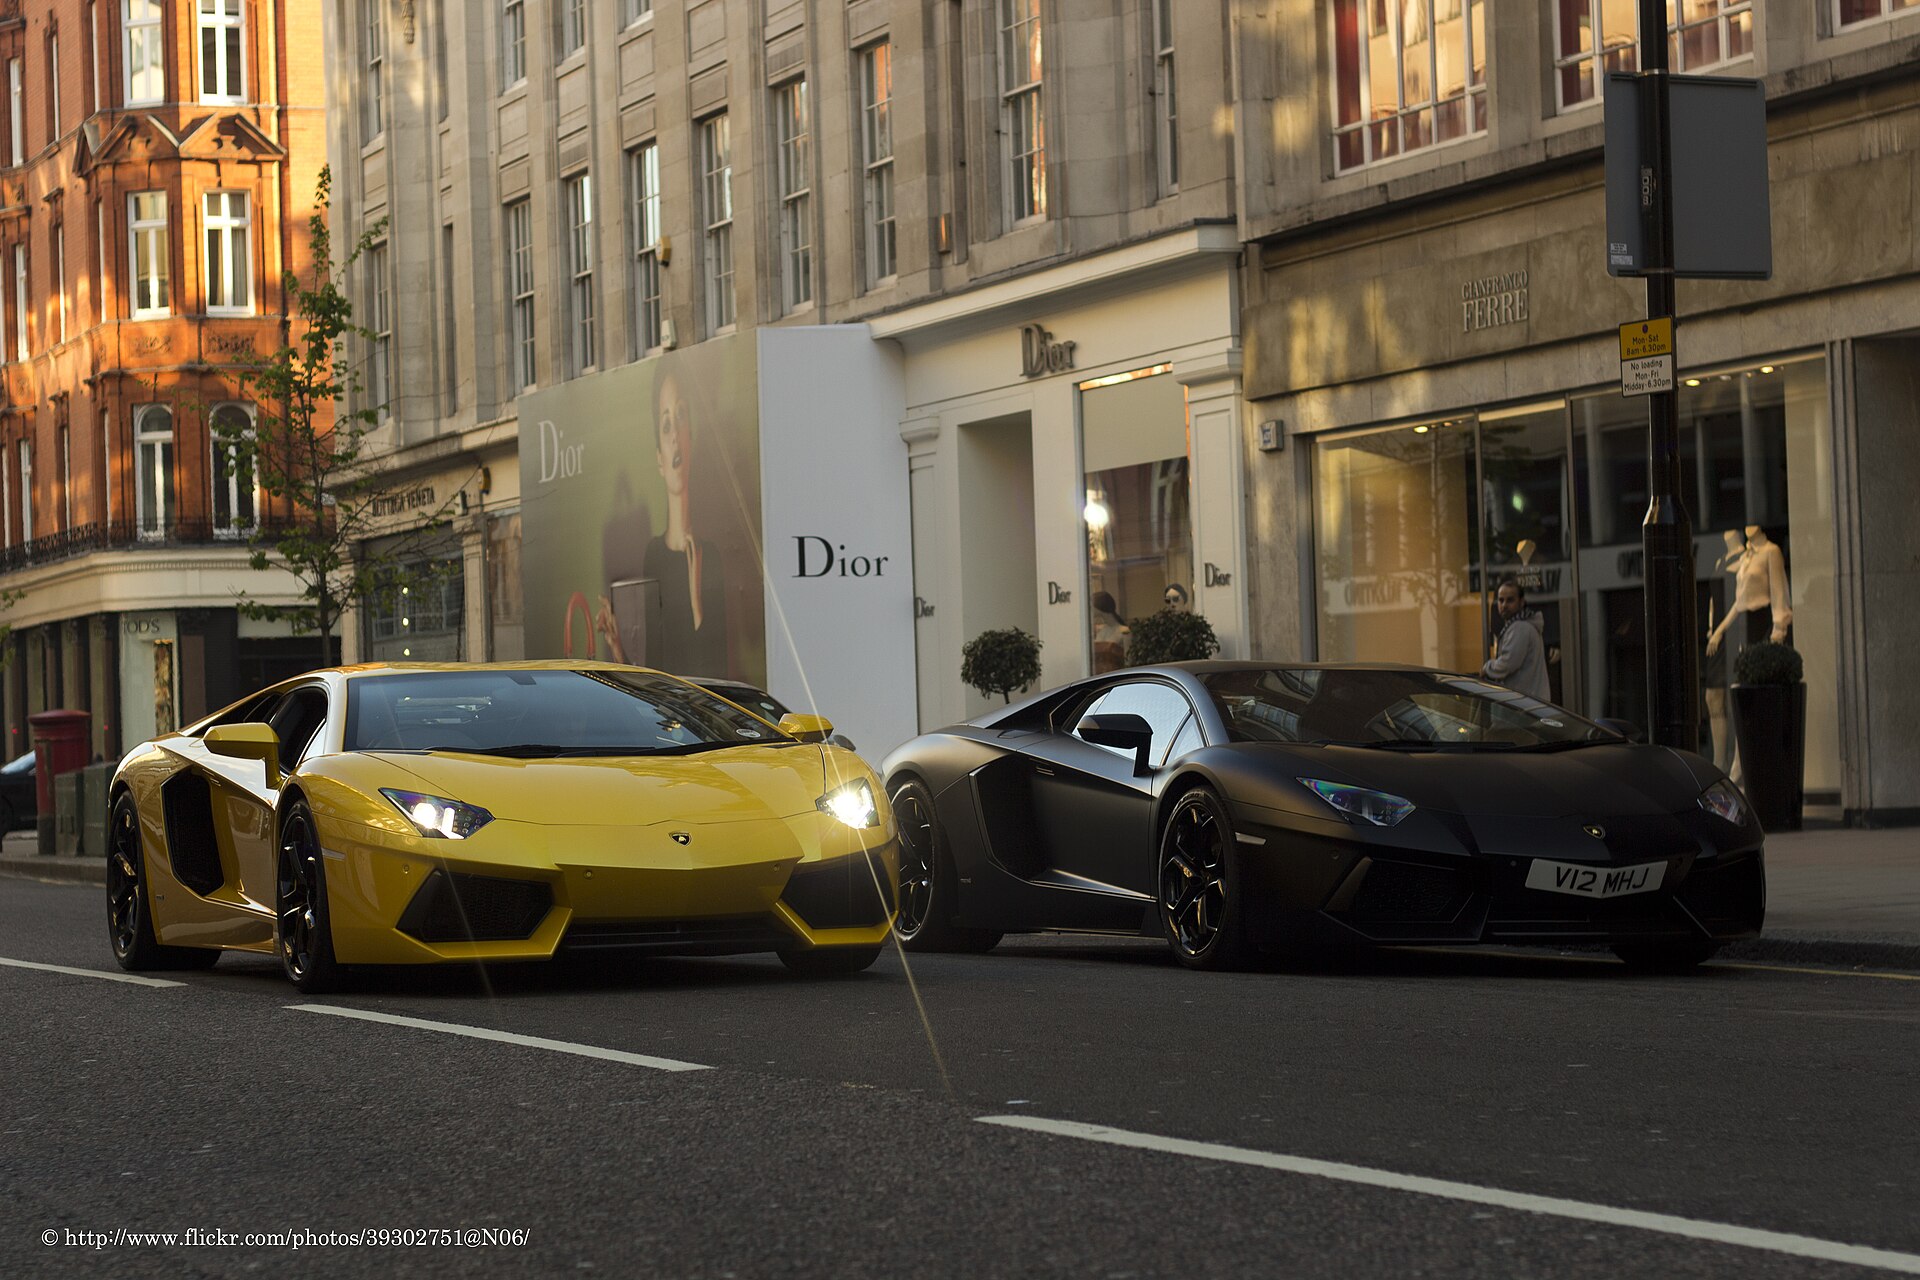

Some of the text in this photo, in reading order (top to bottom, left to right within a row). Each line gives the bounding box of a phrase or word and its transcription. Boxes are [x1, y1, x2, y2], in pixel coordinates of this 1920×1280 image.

[1461, 269, 1528, 300] GIANFRANCO
[1462, 288, 1529, 332] FERRE
[1018, 323, 1077, 379] Dior
[1631, 359, 1663, 371] No loading
[537, 419, 585, 484] Dior
[791, 535, 889, 578] Dior
[1204, 562, 1232, 588] Dior
[914, 596, 935, 618] Dior
[1048, 581, 1072, 605] Dior
[1556, 866, 1650, 895] V12 MHJ
